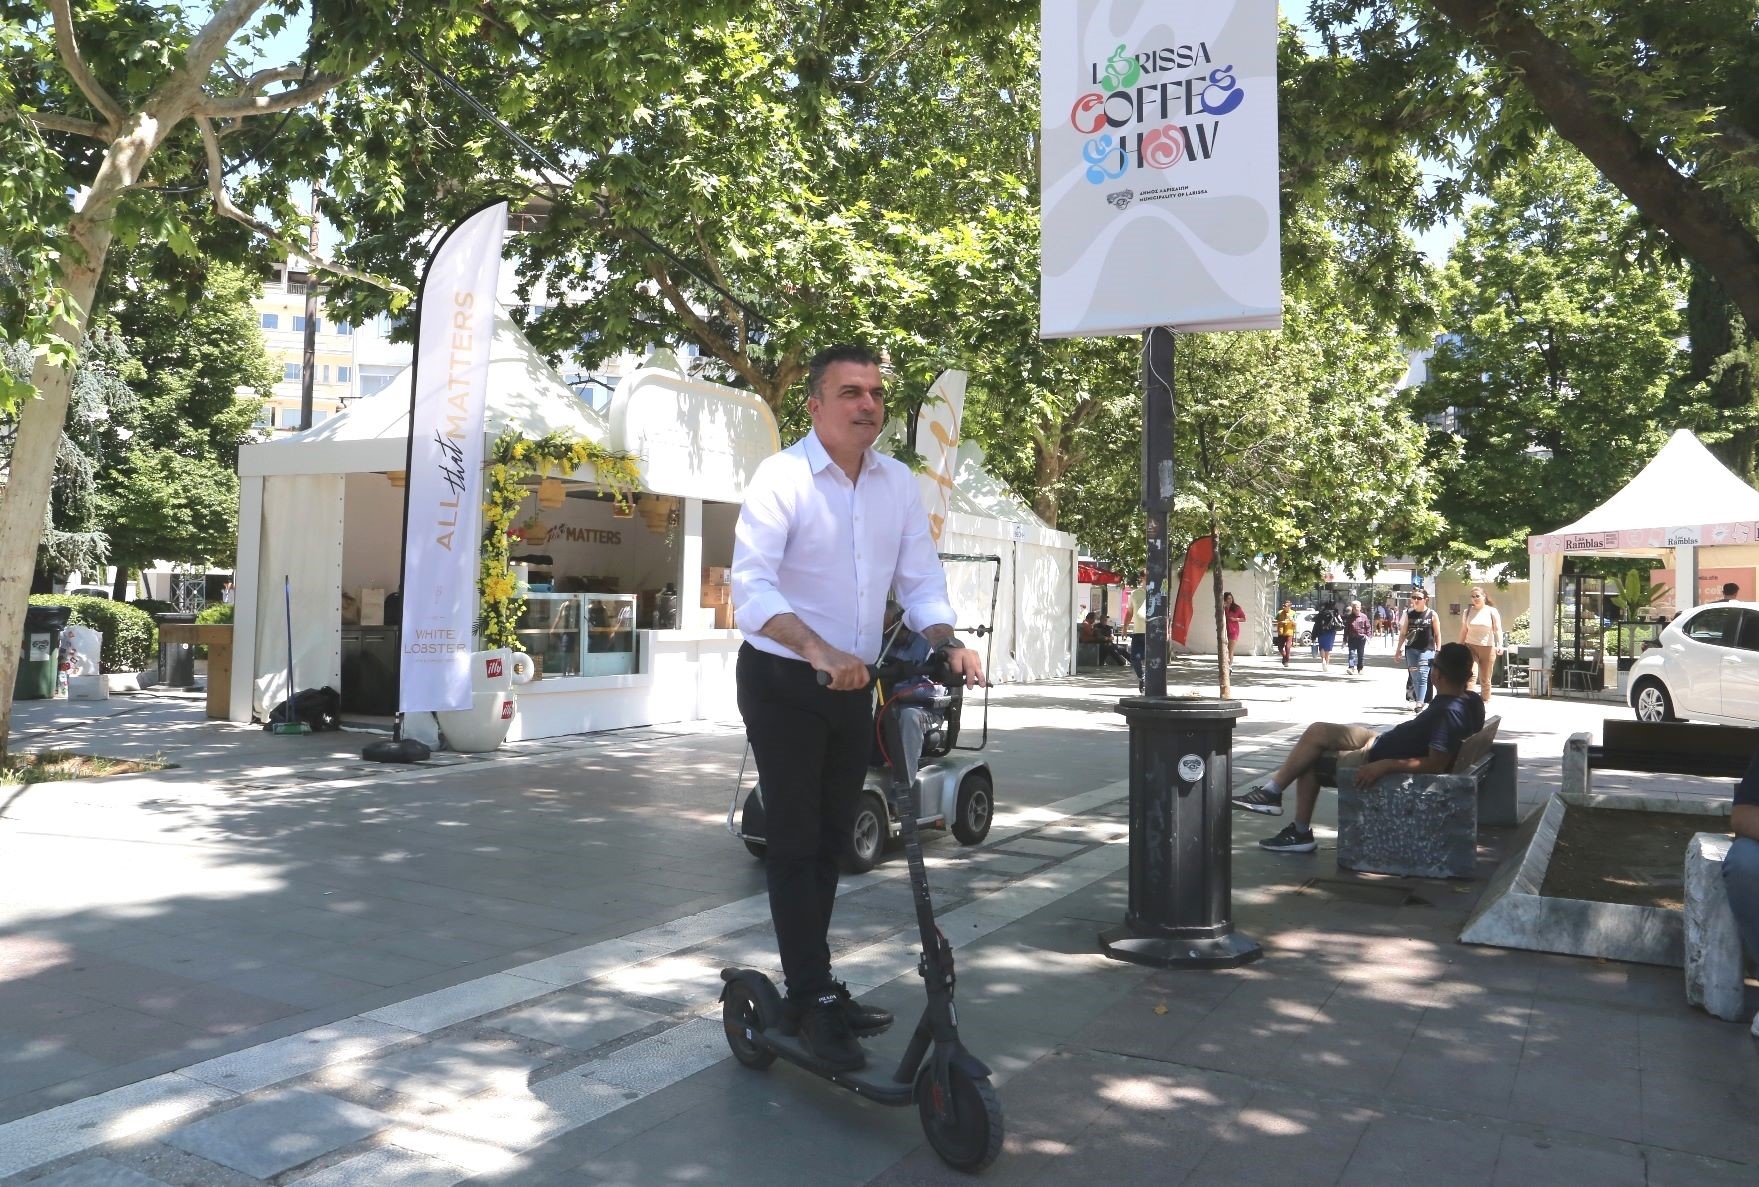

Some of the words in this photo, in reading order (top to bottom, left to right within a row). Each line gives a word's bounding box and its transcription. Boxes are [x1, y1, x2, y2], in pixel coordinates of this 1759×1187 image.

[1092, 42, 1212, 92] LARISSA
[1071, 65, 1244, 134] COFFEE
[1083, 121, 1220, 185] SHOW
[1139, 193, 1177, 202] MUNICIPALITY
[446, 290, 475, 440] MATTERS
[434, 428, 466, 495] that
[436, 491, 461, 552] ALL
[566, 527, 622, 545] MATTERS
[1565, 538, 1604, 550] Ramblas
[1667, 537, 1699, 546] Ramblas
[416, 629, 456, 640] WHITE
[404, 643, 466, 654] LOBSTER
[488, 662, 502, 675] illy
